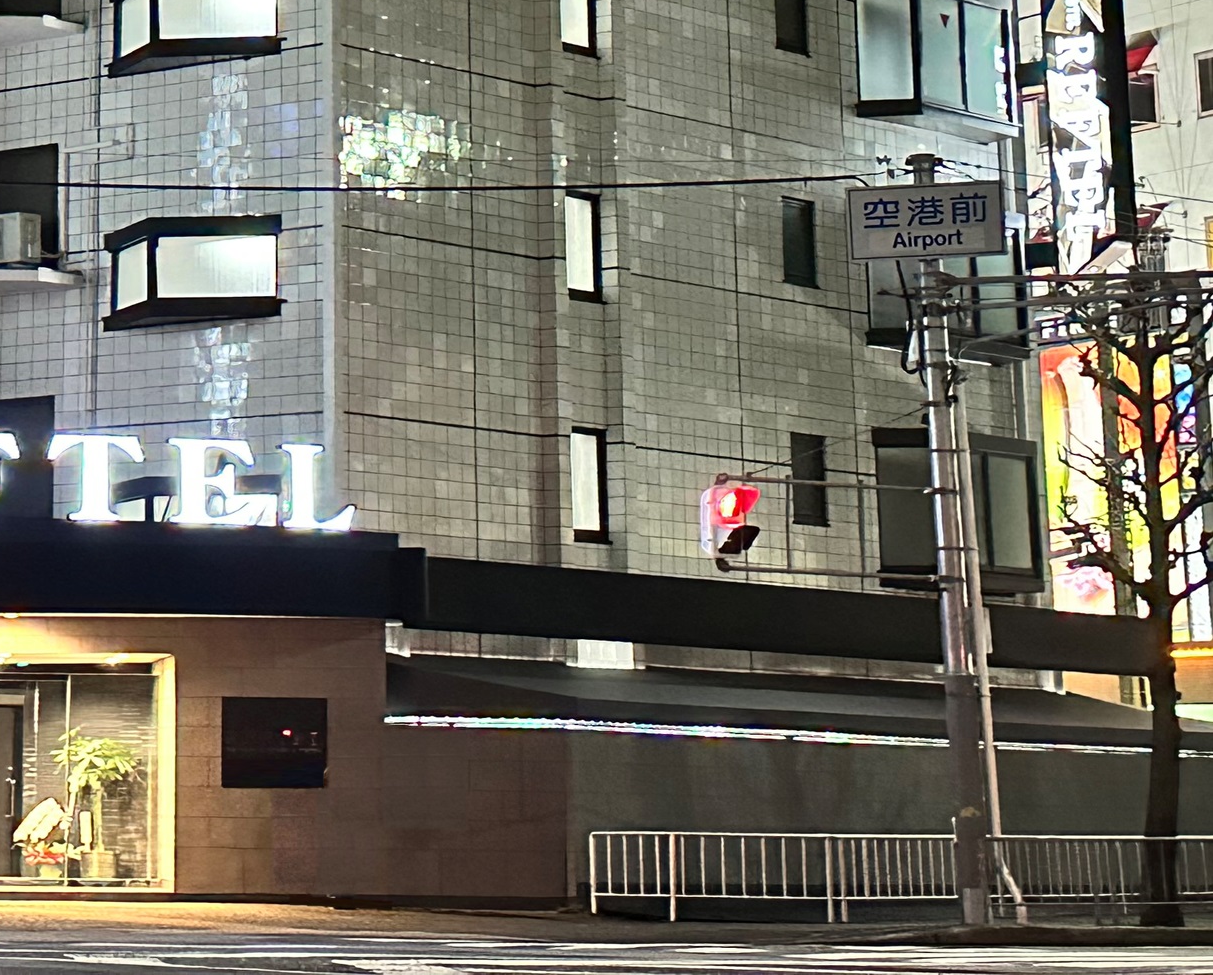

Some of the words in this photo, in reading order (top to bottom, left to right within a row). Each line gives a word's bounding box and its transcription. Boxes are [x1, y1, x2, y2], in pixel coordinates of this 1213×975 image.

[863, 192, 988, 229] 空港前
[892, 229, 963, 251] Airport
